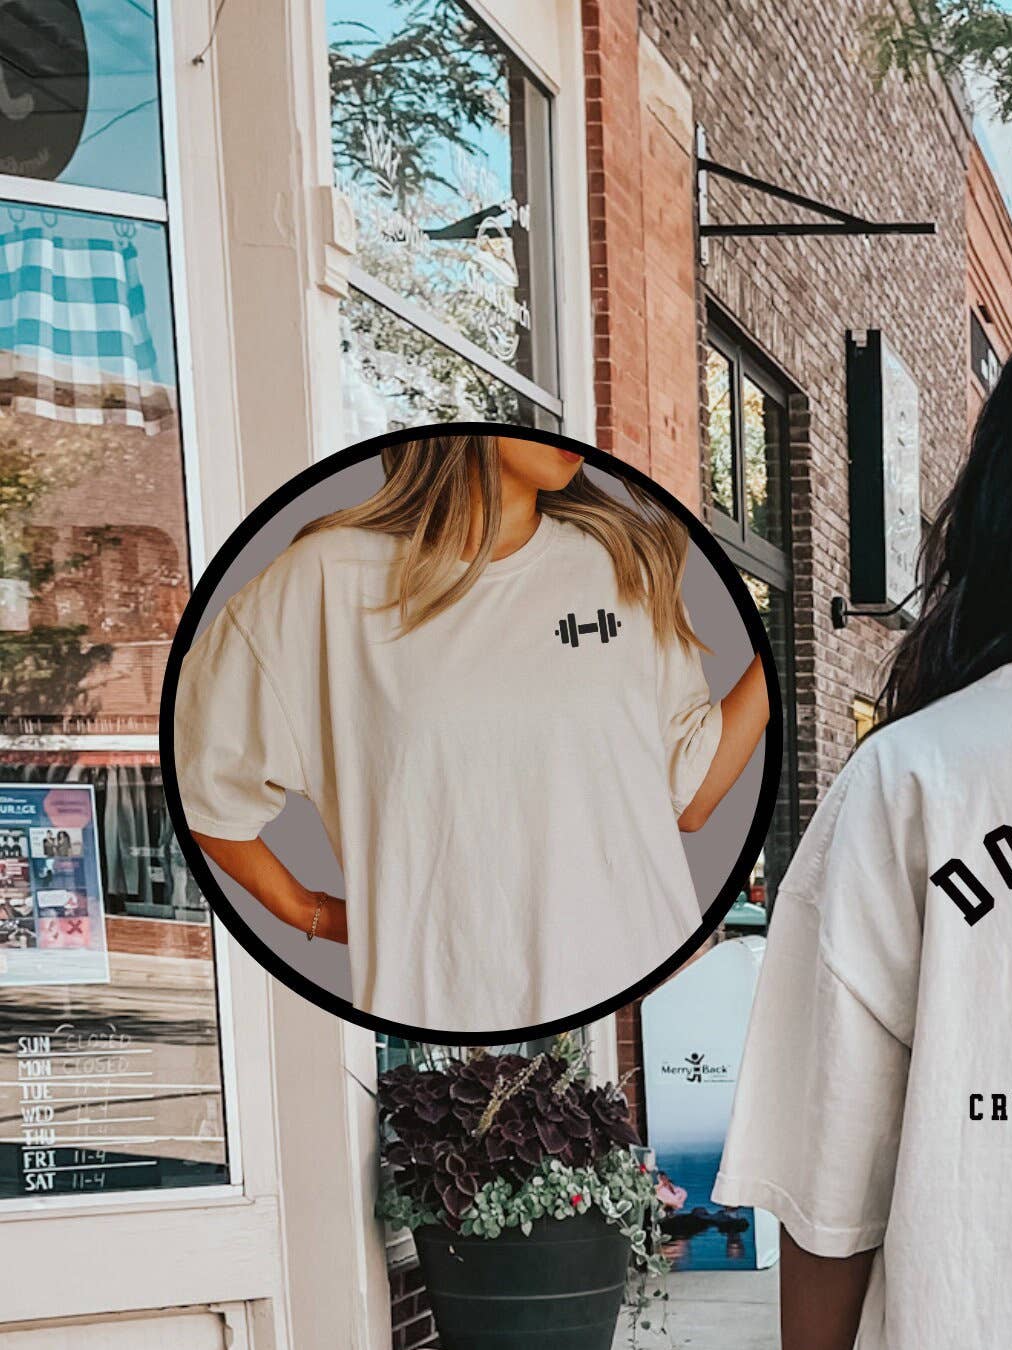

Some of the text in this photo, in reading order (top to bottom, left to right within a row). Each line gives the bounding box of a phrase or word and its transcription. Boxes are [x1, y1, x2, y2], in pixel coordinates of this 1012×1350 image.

[18, 1036, 51, 1054] SUN
[18, 1057, 129, 1077] MON CLOSED
[661, 1065, 728, 1075] Merry Back
[22, 1083, 53, 1100] TUE
[22, 1105, 55, 1123] WED
[22, 1128, 56, 1145] THU
[23, 1150, 106, 1169] FRI 11-4
[25, 1172, 106, 1191] SAT 11-4
